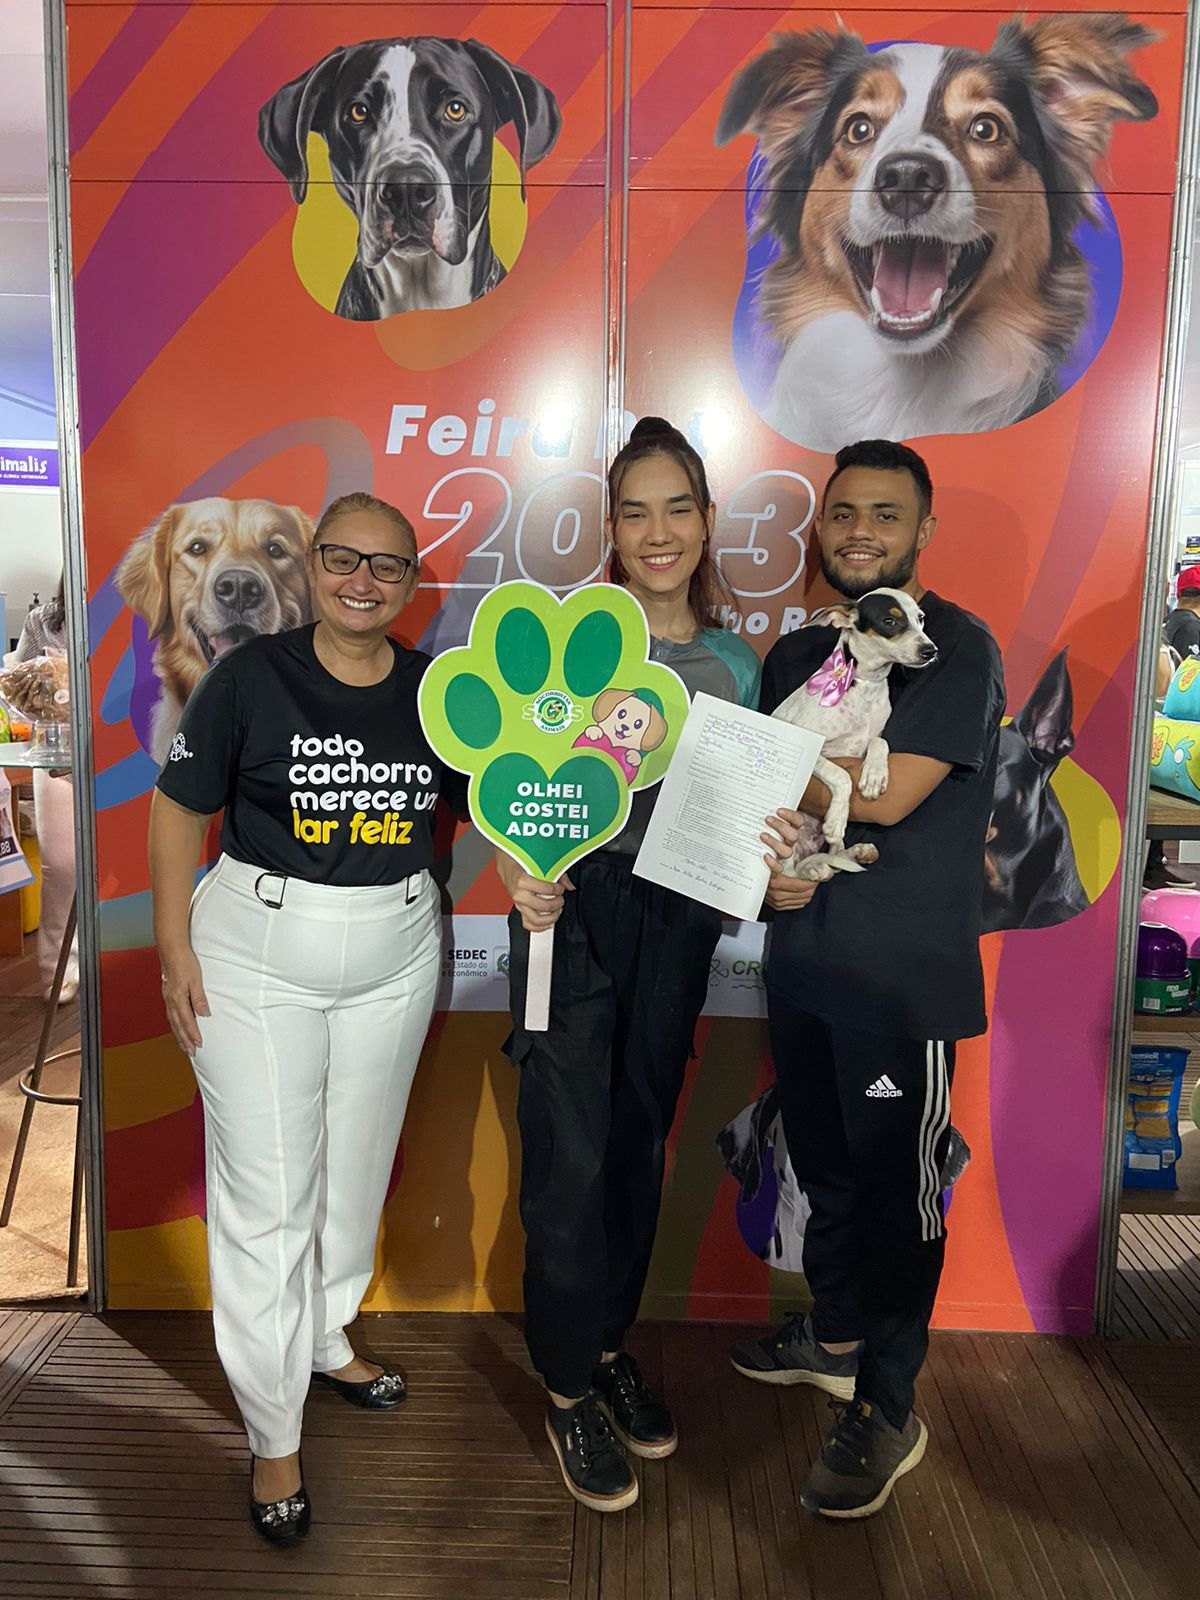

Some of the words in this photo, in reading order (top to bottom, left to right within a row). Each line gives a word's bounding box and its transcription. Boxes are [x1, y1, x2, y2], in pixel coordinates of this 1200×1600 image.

[417, 467, 816, 598] 203
[290, 734, 364, 757] todo
[289, 758, 432, 785] cachorro
[517, 782, 582, 799] OLHEI
[290, 790, 407, 811] merece
[509, 802, 588, 819] GOSTEI
[292, 809, 339, 844] lar
[350, 812, 414, 845] feliz
[506, 821, 589, 839] ADOTEI
[448, 949, 487, 960] SEDEC
[865, 1088, 903, 1098] adidas
